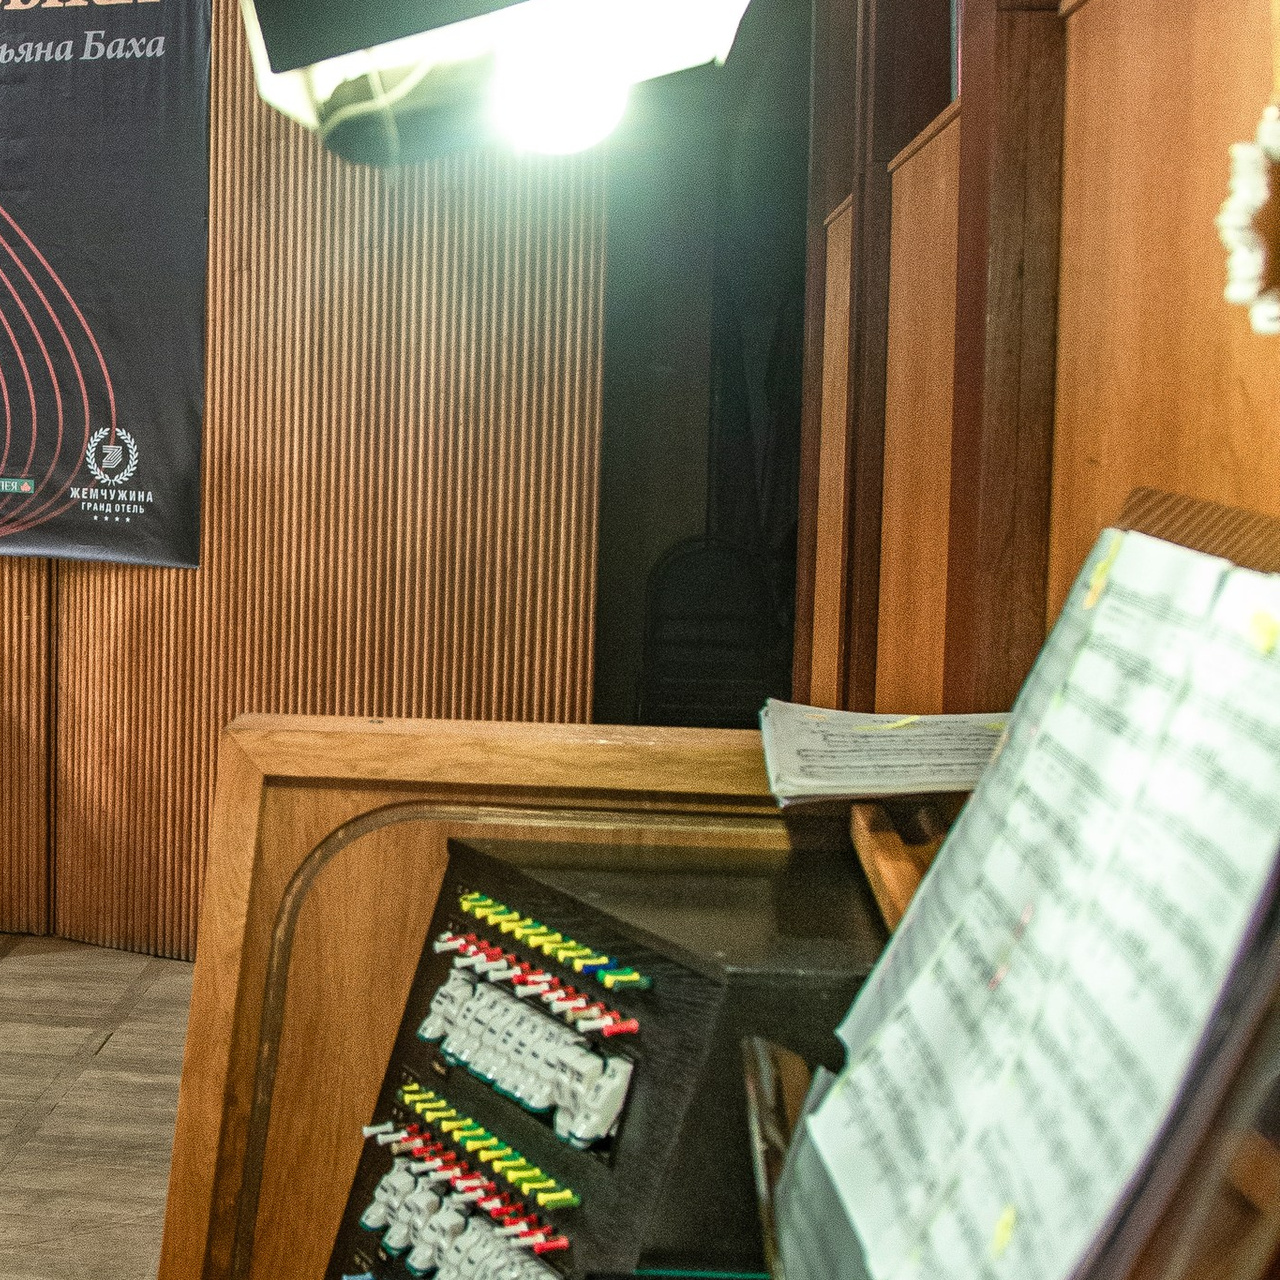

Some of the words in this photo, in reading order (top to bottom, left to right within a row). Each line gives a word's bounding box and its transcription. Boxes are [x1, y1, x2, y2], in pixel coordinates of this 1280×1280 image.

[79, 30, 166, 61] Баха
[70, 487, 153, 502] ЖЕМЧУЖИНА
[81, 502, 112, 513] ГРАНД
[114, 503, 145, 514] ОТЕЛЬ
